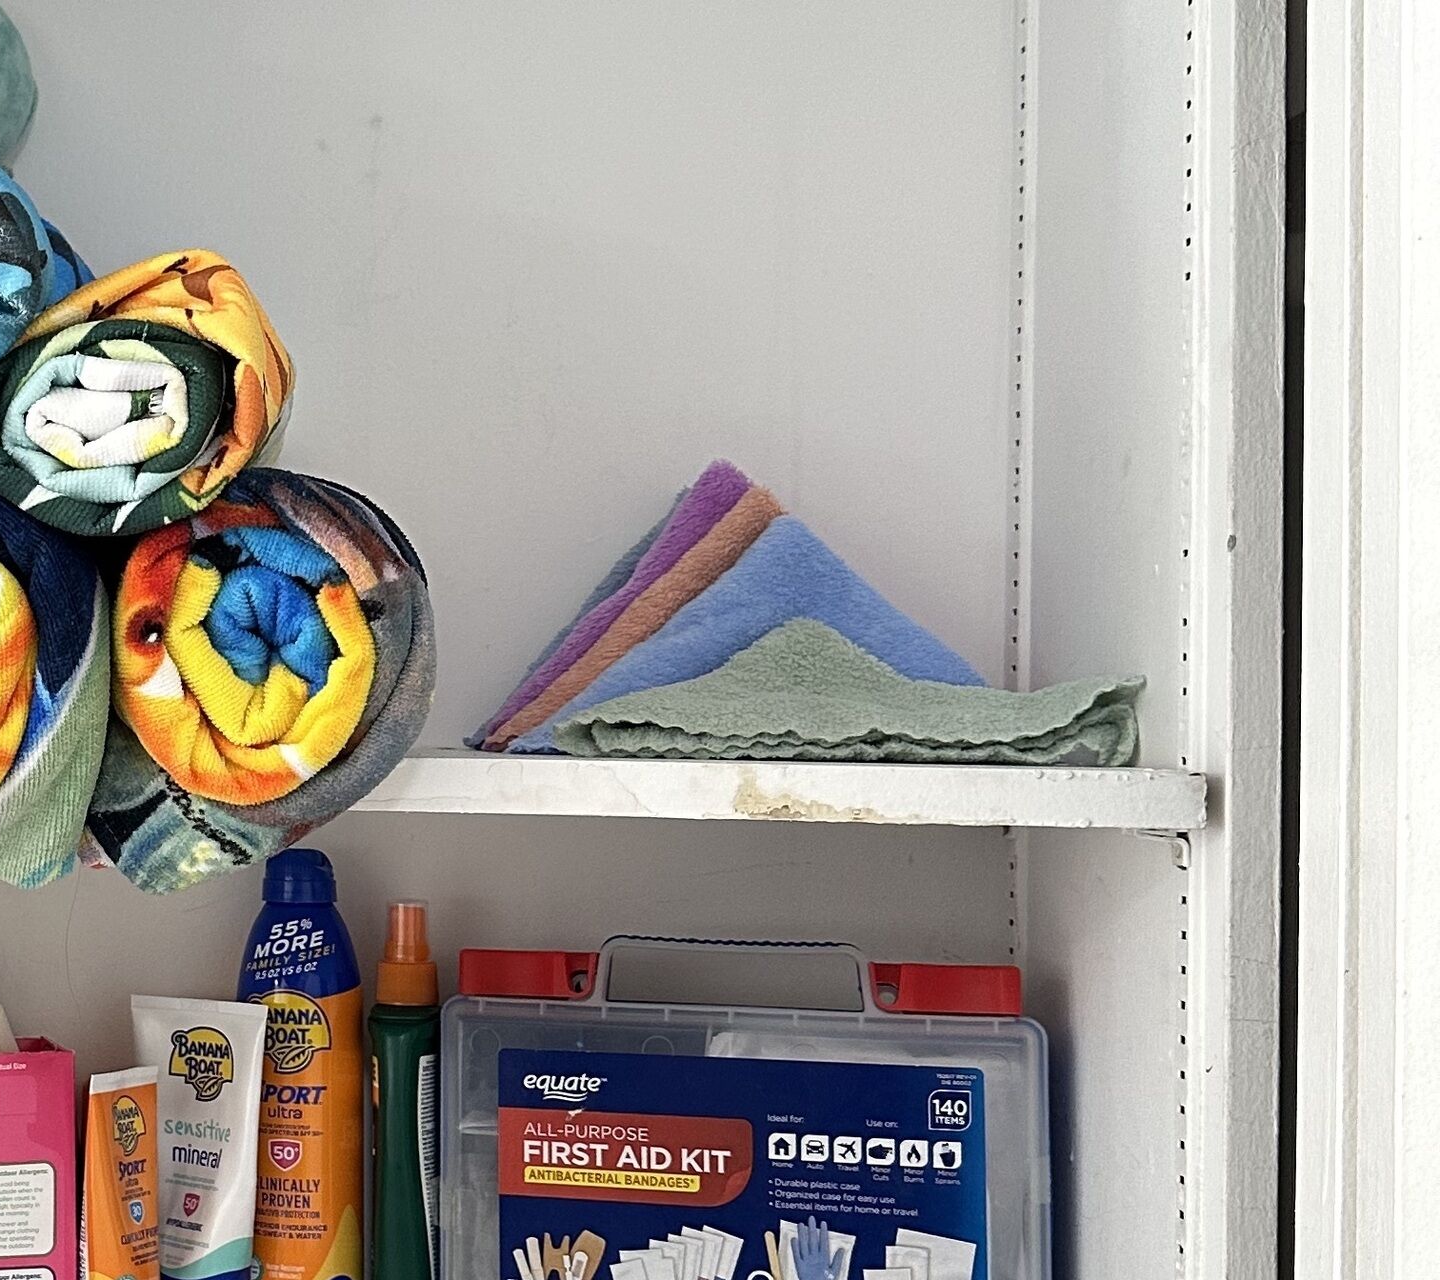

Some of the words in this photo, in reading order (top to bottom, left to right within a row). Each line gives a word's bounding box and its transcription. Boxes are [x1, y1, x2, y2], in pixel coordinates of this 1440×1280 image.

[269, 918, 312, 941] 55%
[254, 930, 324, 960] MORE
[246, 954, 291, 972] FAMILY
[298, 943, 336, 962] SIZE!
[254, 969, 267, 981] 9.5
[268, 967, 281, 978] OZ
[282, 965, 295, 976] VS
[296, 963, 302, 974] 6
[304, 961, 318, 972] OZ
[266, 1007, 323, 1025] ANANA
[175, 1034, 230, 1060] BANANA
[13, 1062, 27, 1070] Size
[523, 1073, 601, 1093] equate
[268, 1105, 303, 1120] ultra
[932, 1099, 968, 1116] 140
[767, 1114, 789, 1122] Ideal
[789, 1114, 805, 1123] for:
[866, 1119, 883, 1127] Use
[934, 1115, 965, 1126] ITEMS
[164, 1119, 231, 1143] sensitive
[524, 1122, 649, 1142] ALL-PURPOSE
[172, 1144, 223, 1169] mineral
[273, 1146, 300, 1161] 50+
[523, 1140, 610, 1167] FIRST
[617, 1145, 673, 1170] AID
[681, 1148, 732, 1173] KIT
[118, 1158, 147, 1181] SPORT
[772, 1161, 794, 1169] Home
[806, 1162, 825, 1170] Auto
[837, 1163, 860, 1171] Travel
[903, 1168, 924, 1176] Minor
[258, 1177, 321, 1193] LINICALLY
[528, 1169, 622, 1185] ANTIBACTERIAL
[775, 1178, 809, 1188] Durable
[810, 1180, 839, 1191] plastic
[840, 1182, 861, 1191] case
[873, 1174, 889, 1182] Cuts
[904, 1176, 925, 1184] Burns
[261, 1193, 311, 1209] PROVEN
[775, 1189, 820, 1200] Organized
[822, 1192, 842, 1201] case
[843, 1192, 856, 1201] for
[857, 1194, 878, 1204] easy
[879, 1195, 896, 1204] use
[131, 1206, 142, 1217] 30
[775, 1200, 813, 1210] Essential
[814, 1202, 839, 1212] items
[840, 1204, 853, 1213] for
[854, 1204, 881, 1214] home
[881, 1207, 892, 1215] or
[893, 1207, 919, 1217] travel
